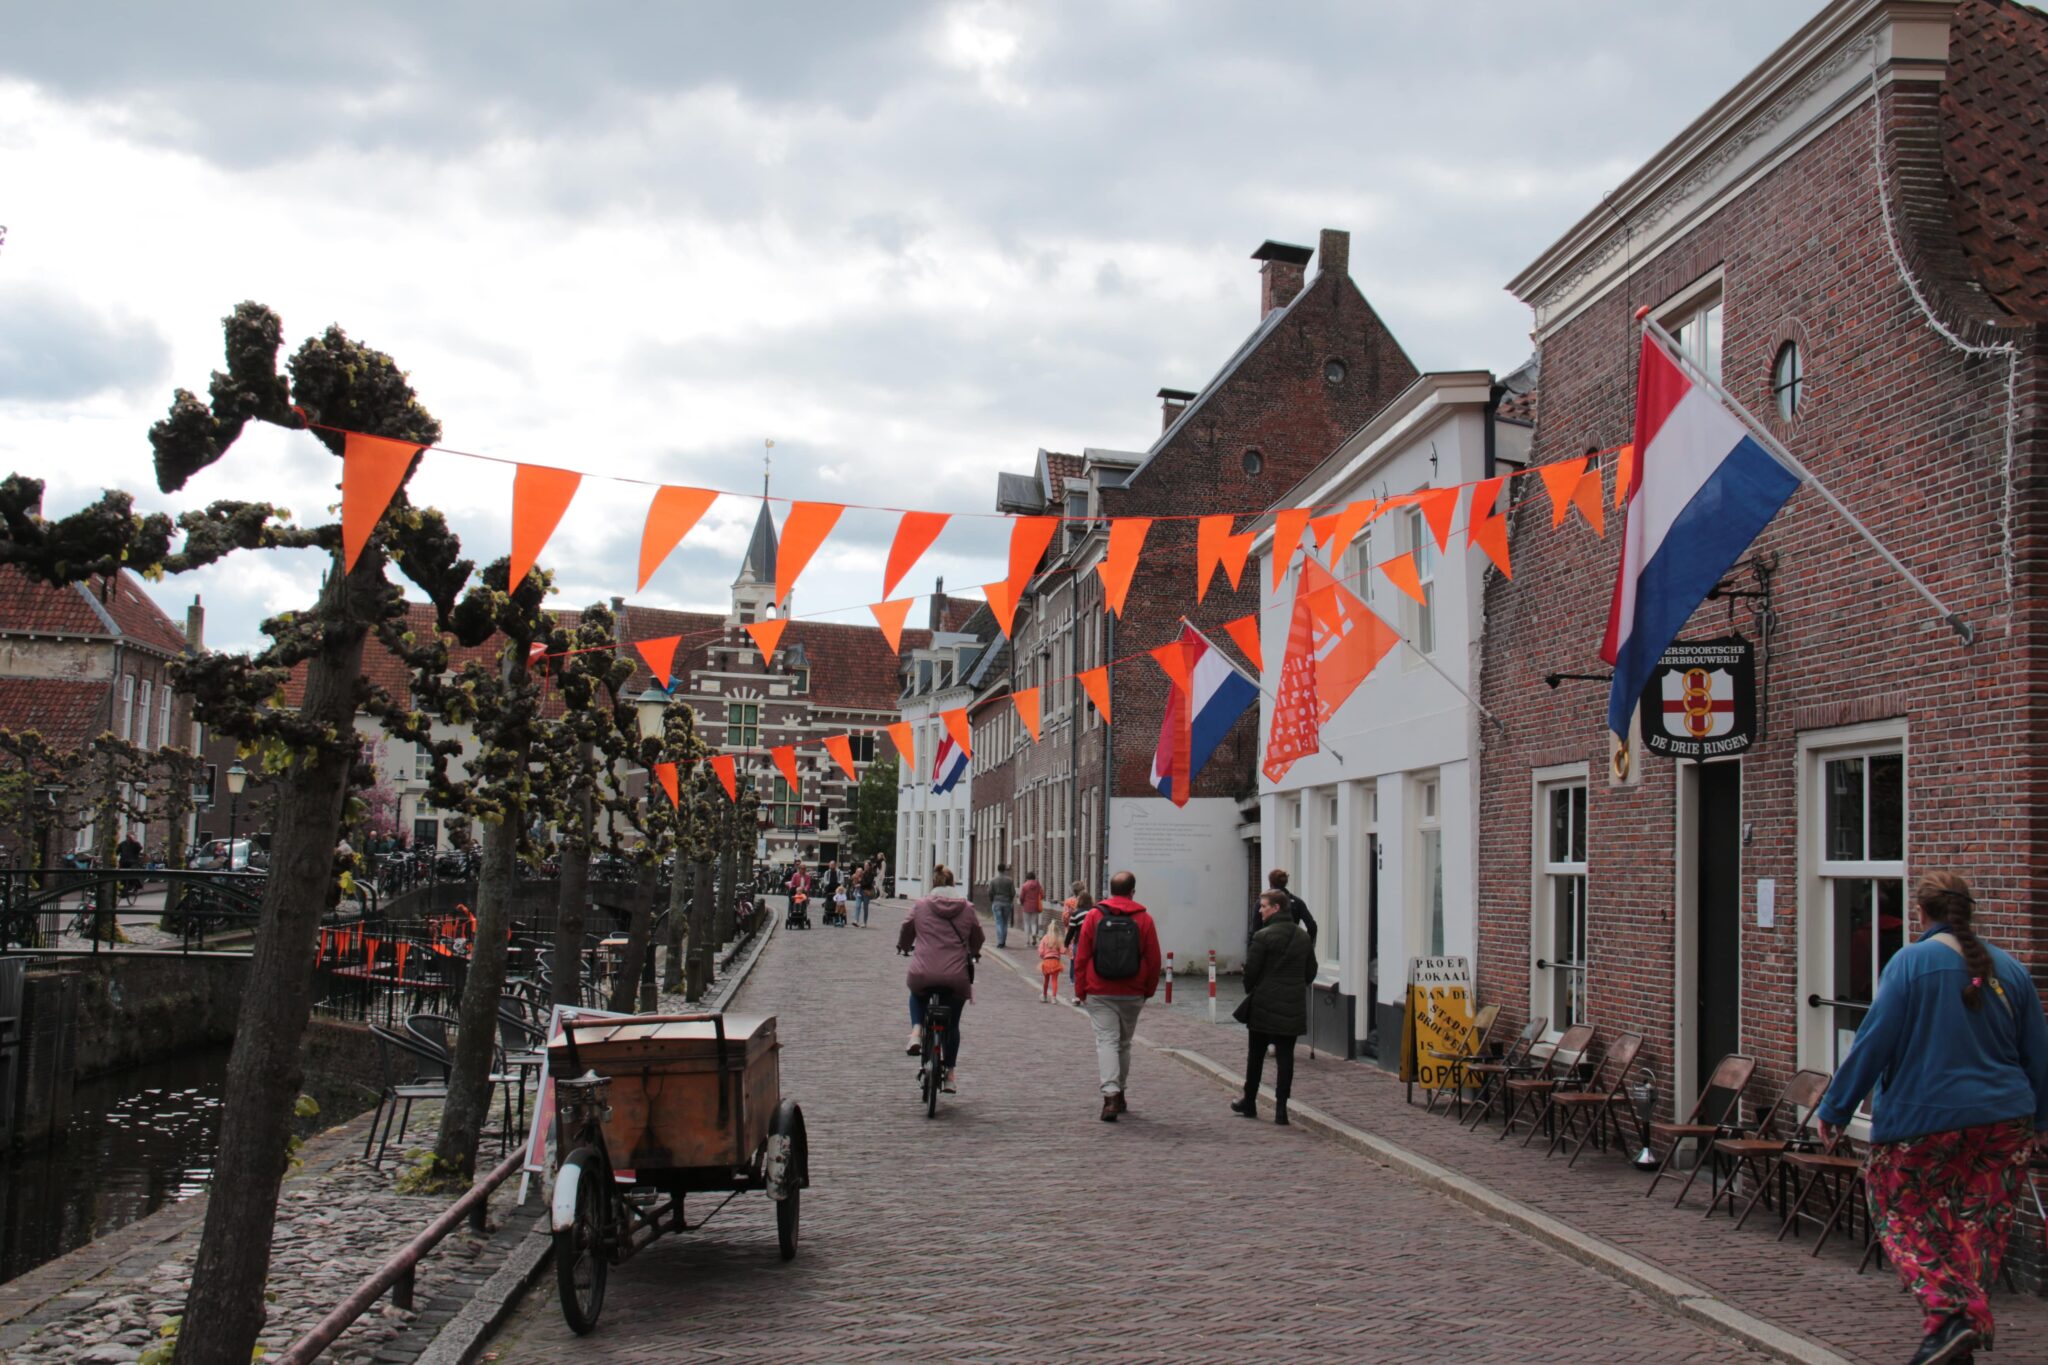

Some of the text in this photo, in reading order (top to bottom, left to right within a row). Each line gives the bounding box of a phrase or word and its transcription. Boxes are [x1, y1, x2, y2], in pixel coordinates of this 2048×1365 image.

[1664, 646, 1745, 655] ERSFOORTSCHE
[1650, 733, 1749, 755] DE DRIE RINGEN
[1416, 958, 1465, 969] PROEF
[1416, 971, 1470, 982] LOKAAL
[1418, 990, 1469, 1000] VAN DE
[1430, 1004, 1468, 1036] STADS
[1420, 1041, 1434, 1050] IS
[1420, 1065, 1483, 1084] OPEN
